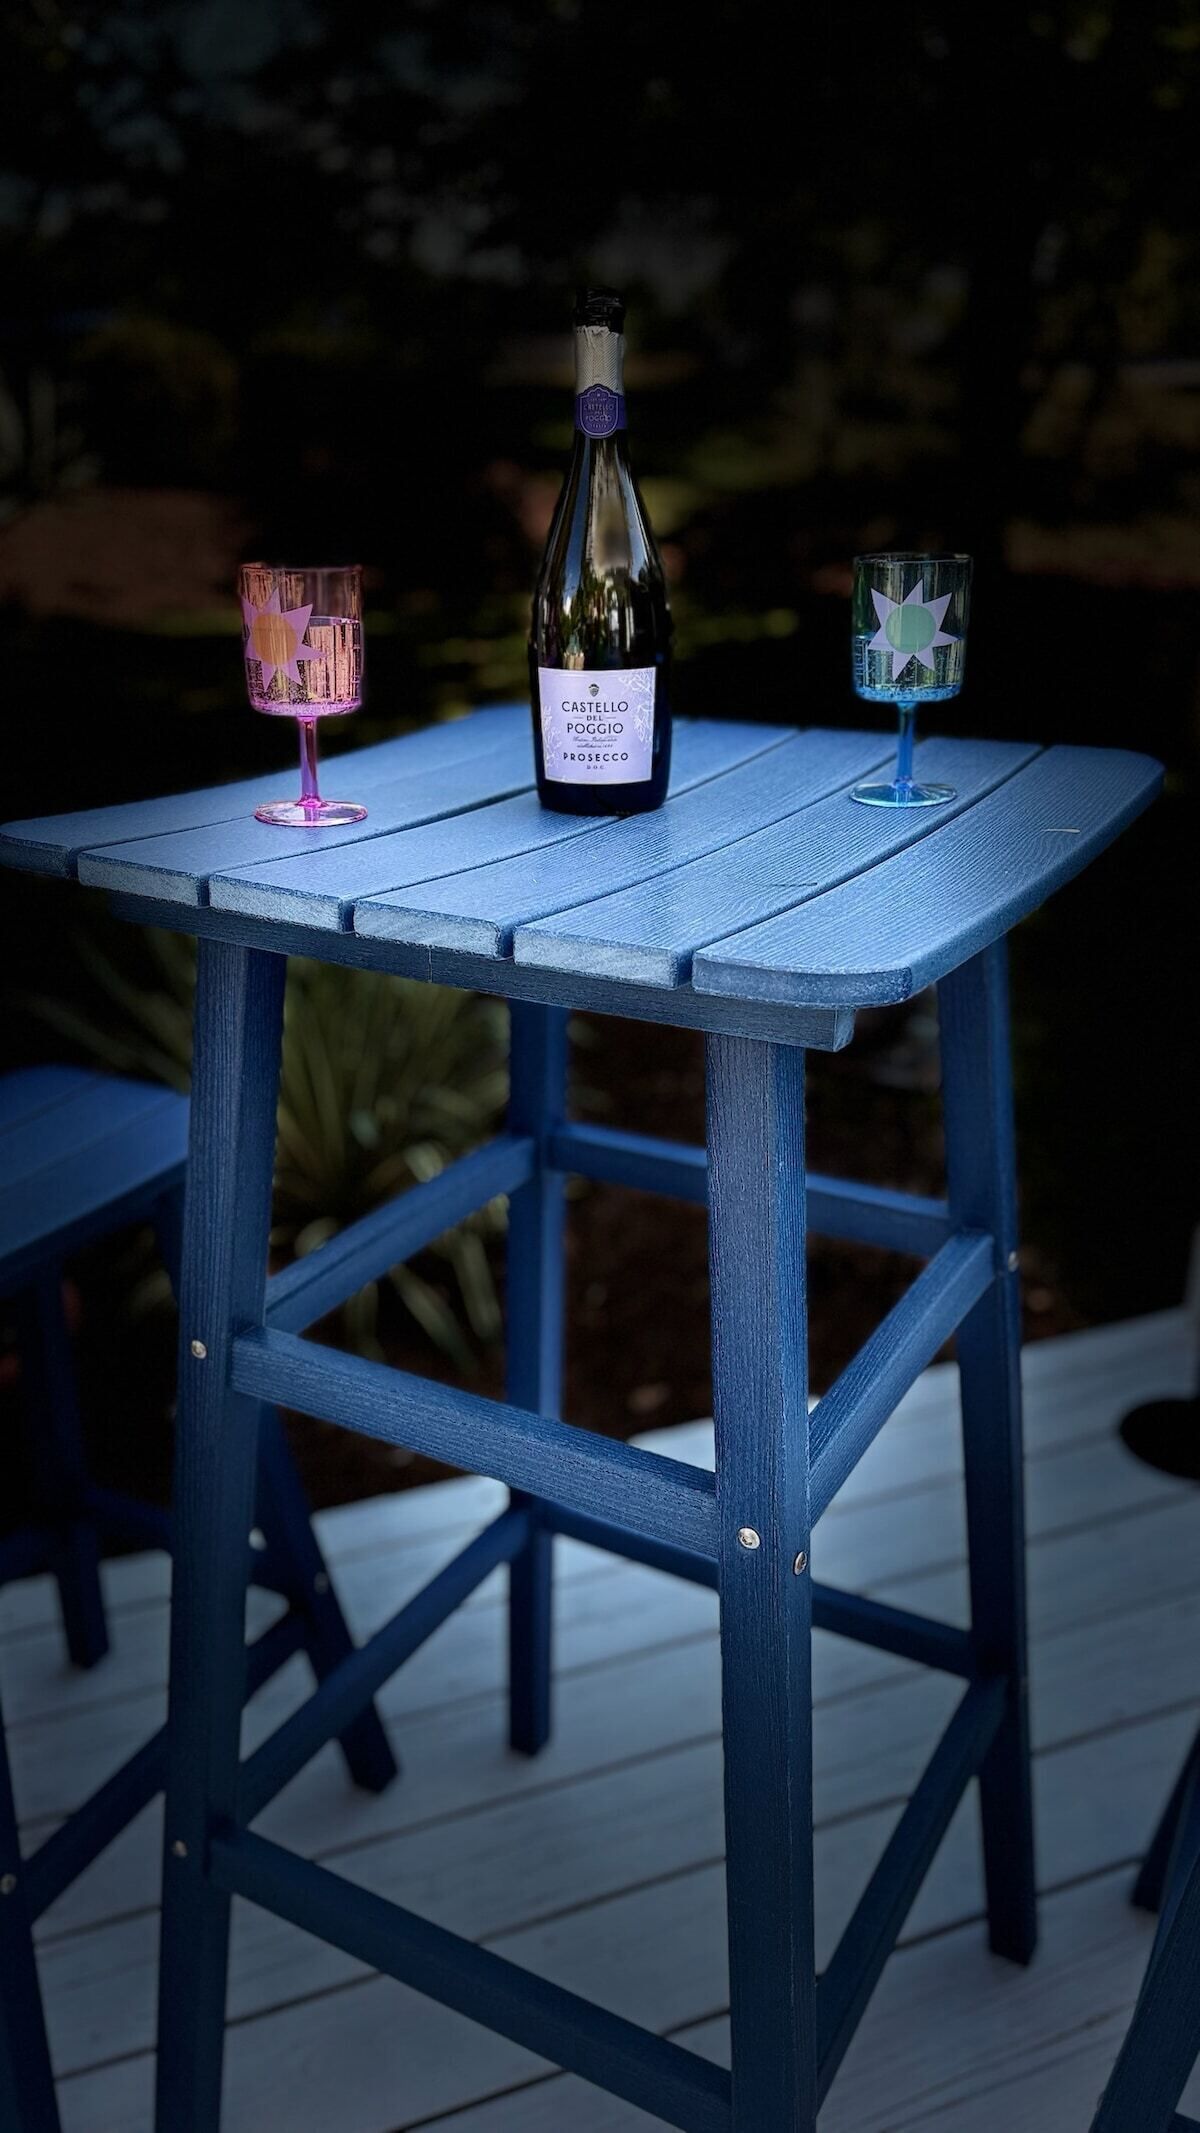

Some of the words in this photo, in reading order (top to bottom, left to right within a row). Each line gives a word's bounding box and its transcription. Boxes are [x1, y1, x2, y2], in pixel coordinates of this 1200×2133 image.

[561, 701, 629, 713] CASTELLO
[567, 723, 624, 735] POGGIO
[563, 753, 629, 762] PROSECCO
